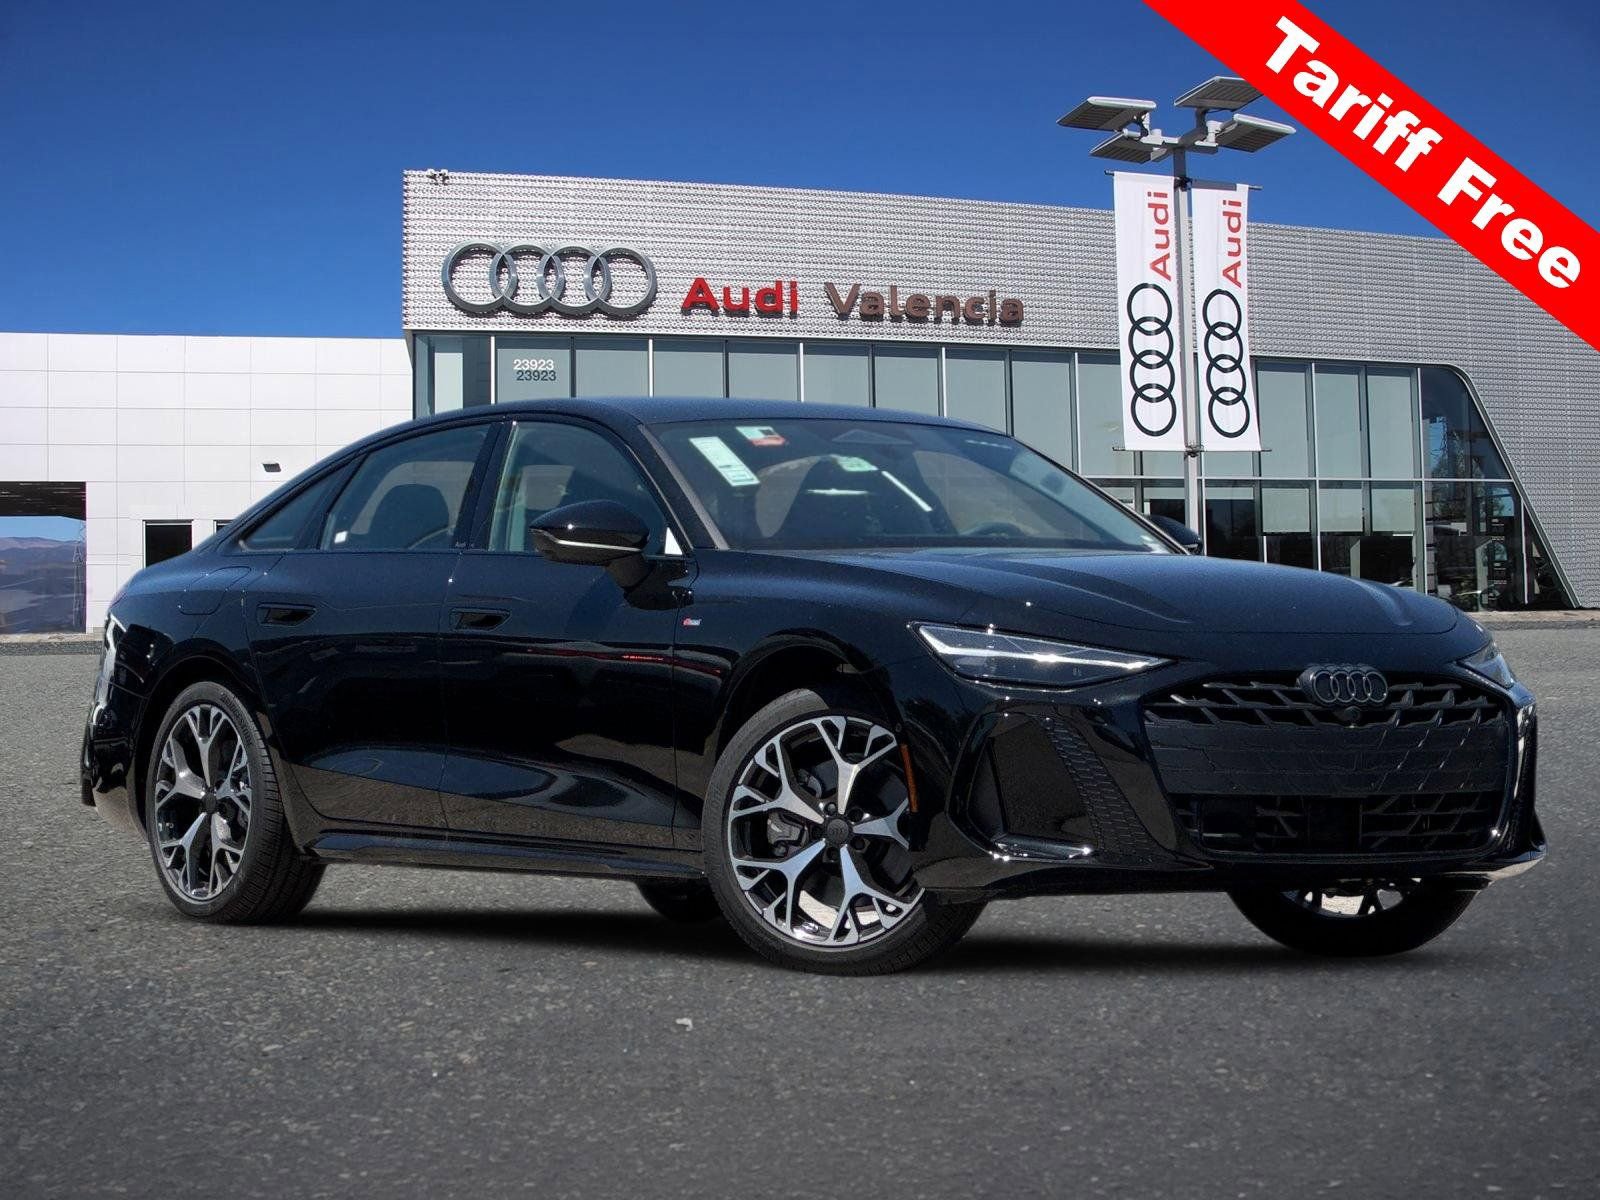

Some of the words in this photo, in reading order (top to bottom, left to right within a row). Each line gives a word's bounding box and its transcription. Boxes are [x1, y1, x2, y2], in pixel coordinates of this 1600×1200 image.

[1147, 191, 1172, 281] Audi
[1222, 199, 1243, 288] Audi
[681, 277, 799, 317] Audi
[825, 282, 1025, 325] Valencia
[513, 359, 555, 371] 23923
[515, 370, 557, 382] 23923
